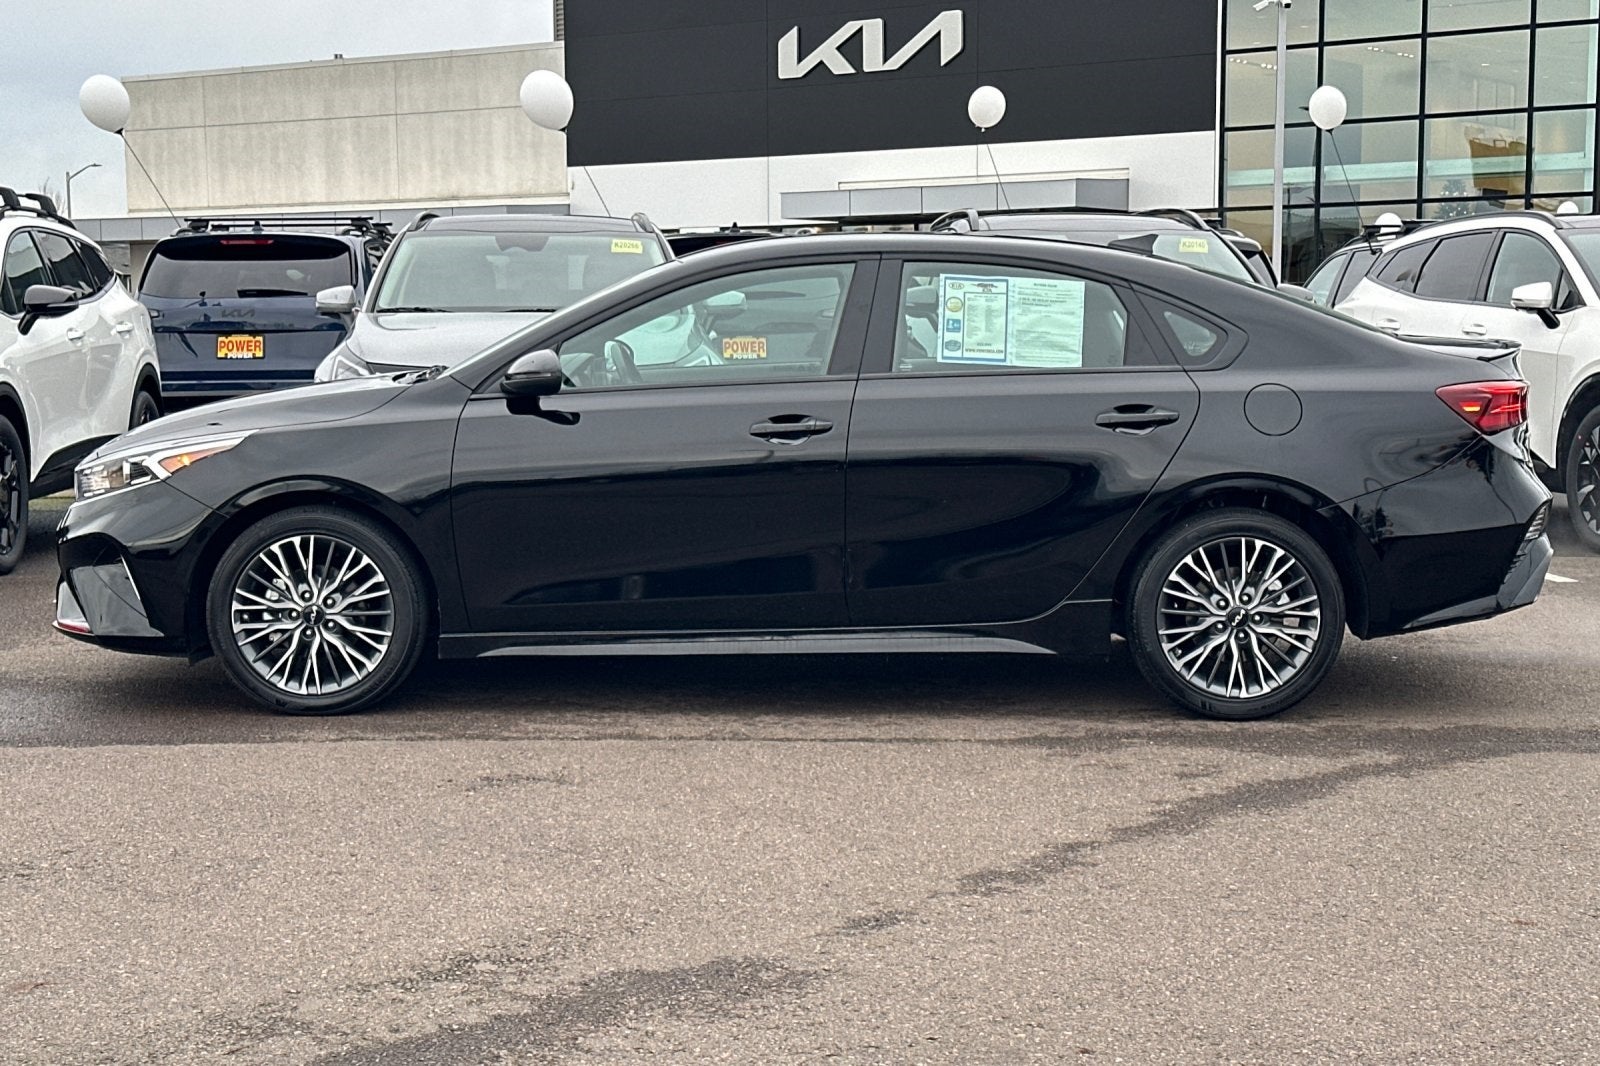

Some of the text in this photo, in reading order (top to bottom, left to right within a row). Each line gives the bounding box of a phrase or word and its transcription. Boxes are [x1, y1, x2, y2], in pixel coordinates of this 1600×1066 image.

[778, 9, 963, 80] KIA
[219, 340, 262, 352] POWER
[724, 340, 765, 353] POWER
